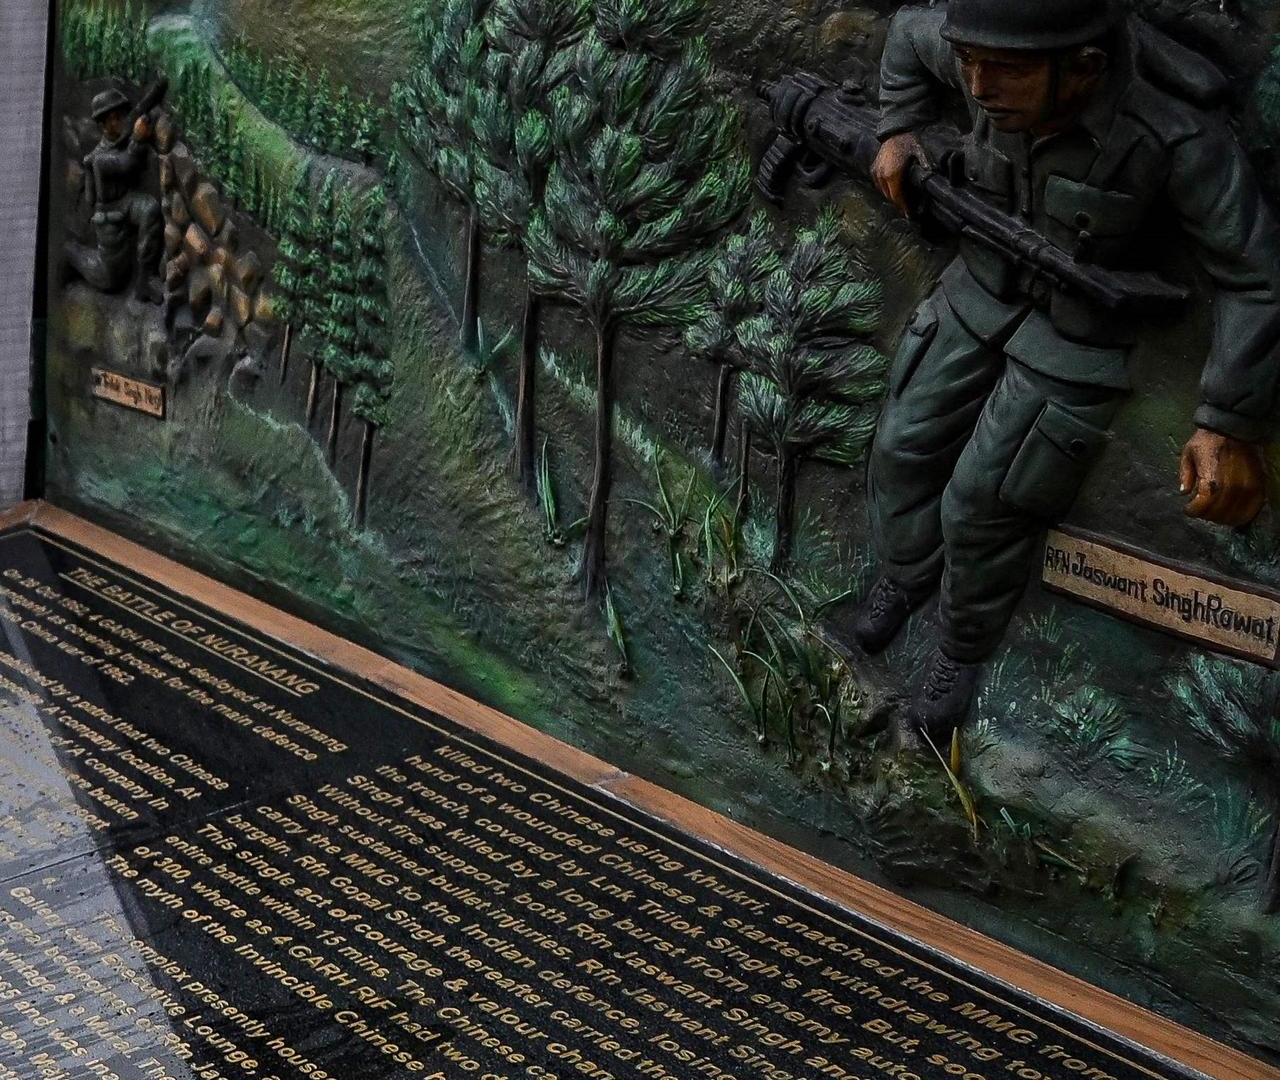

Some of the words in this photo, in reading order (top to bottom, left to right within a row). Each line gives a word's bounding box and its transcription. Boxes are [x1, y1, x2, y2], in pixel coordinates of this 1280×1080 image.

[69, 566, 108, 588] THE
[101, 584, 176, 622] BATTLE
[170, 619, 206, 634] OF
[198, 633, 320, 694] NURANANG
[1043, 545, 1071, 575] RFN
[1072, 551, 1147, 604] Jaswant
[49, 683, 72, 696] by
[65, 694, 81, 703] a
[71, 700, 123, 724] patrol
[113, 721, 148, 741] that
[140, 737, 171, 756] two
[159, 652, 191, 669] was
[187, 667, 259, 703] deployed
[251, 700, 275, 713] at
[268, 708, 349, 753] Nuranang
[163, 676, 191, 690] for
[186, 688, 215, 705] the
[211, 703, 254, 727] main
[251, 725, 319, 761] defence
[57, 714, 121, 752] company
[116, 749, 176, 788] location.
[174, 786, 202, 800] At
[168, 753, 230, 791] Chinese
[132, 845, 162, 859] of
[152, 856, 192, 884] 300,
[191, 881, 248, 919] where
[244, 918, 273, 935] as
[271, 935, 294, 945] 4
[288, 944, 357, 987] GARH
[349, 985, 397, 1010] RIF
[388, 1011, 442, 1042] had
[435, 1041, 481, 1071] two
[164, 835, 214, 865] entire
[210, 862, 262, 896] battle
[259, 894, 317, 930] within
[315, 929, 347, 946] 15
[337, 945, 391, 978] mins.
[396, 978, 437, 1006] The
[436, 1006, 526, 1064] Chinese
[196, 822, 238, 851] This
[235, 849, 296, 887] single
[293, 886, 333, 908] act
[327, 907, 363, 922] of
[353, 922, 444, 978] courage
[442, 977, 469, 992] &
[468, 991, 549, 1039] valour
[225, 813, 292, 854] bargain.
[293, 854, 331, 877] Rfn
[329, 875, 392, 911] Gopal
[385, 909, 447, 947] Singh
[444, 945, 553, 1008] thereafter
[549, 1009, 642, 1061] carried
[255, 805, 308, 834] carry
[305, 833, 342, 854] the
[339, 852, 400, 886] MMG
[395, 885, 423, 902] to
[421, 900, 462, 925] the
[460, 923, 537, 968] Indian
[537, 969, 640, 1035] defence,
[286, 793, 340, 826] Singh
[337, 824, 435, 877] sustained
[427, 874, 492, 910] bullet
[486, 909, 573, 960] injuries.
[575, 958, 622, 985] Rfn
[621, 987, 731, 1046] Jaswant
[316, 783, 393, 827] Without
[387, 823, 425, 845] fire
[423, 844, 510, 895] support,
[512, 891, 569, 924] both
[567, 922, 614, 949] Rfn
[613, 950, 724, 1009] Jaswant
[721, 1007, 804, 1054] Singh
[346, 774, 405, 807] Singh
[403, 805, 447, 830] was
[445, 827, 512, 862] killed
[505, 859, 540, 878] by
[537, 878, 558, 890] a
[556, 887, 615, 921] long
[611, 917, 687, 958] burst
[683, 955, 749, 992] from
[750, 992, 850, 1044] enemy
[374, 764, 408, 783] the
[406, 780, 470, 819] trench,
[473, 817, 564, 862] covered
[557, 858, 591, 877] by
[588, 875, 636, 902] Lnk
[637, 898, 705, 938] Trilok
[705, 936, 802, 989] Singh's
[801, 987, 853, 1015] fire.
[860, 1017, 920, 1054] But,
[403, 754, 461, 783] hand
[456, 781, 488, 795] of
[479, 794, 498, 804] a
[497, 802, 602, 855] wounded
[598, 853, 697, 905] Chinese
[697, 904, 723, 918] &
[721, 917, 823, 966] started
[820, 965, 1004, 1061] withdrawing
[433, 744, 493, 774] killed
[486, 771, 528, 793] two
[528, 791, 616, 837] Chinese
[615, 836, 685, 872] using
[683, 868, 770, 915] khukri,
[772, 914, 905, 978] snatched
[900, 976, 950, 1003] the
[951, 1001, 1038, 1044] MMG
[104, 853, 139, 878] The
[135, 877, 185, 909] myth
[181, 908, 213, 923] of
[202, 921, 238, 944] the
[233, 943, 334, 1010] invincible
[333, 1009, 425, 1072] Chinese
[181, 981, 271, 1038] presently
[182, 1014, 259, 1075] Lounge,
